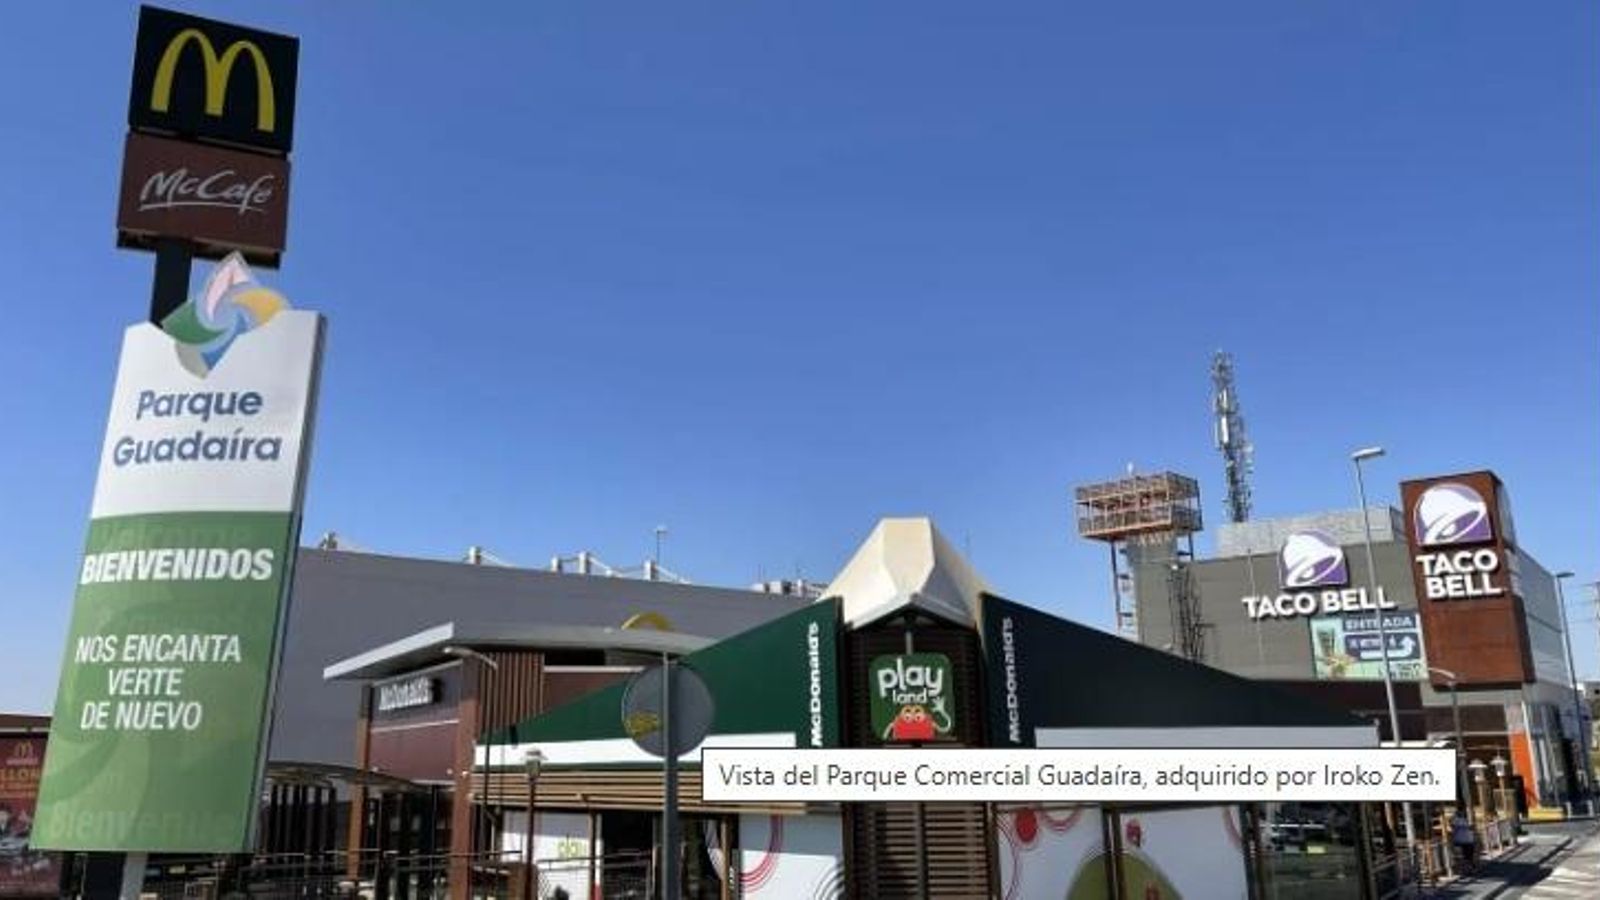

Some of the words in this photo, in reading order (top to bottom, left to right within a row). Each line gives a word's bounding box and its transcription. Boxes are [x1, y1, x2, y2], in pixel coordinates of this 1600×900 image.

[138, 168, 275, 214] McCafé
[136, 390, 263, 421] Parque
[113, 428, 282, 467] Guadaíra
[80, 547, 275, 584] BIENVENIDOS
[1416, 549, 1499, 577] TACO
[1426, 572, 1504, 599] BELL
[1242, 591, 1316, 619] TACO
[1322, 586, 1396, 612] BELL
[75, 635, 118, 663] NOS
[121, 633, 242, 662] ENCANTA
[107, 668, 184, 696] VERTE
[877, 657, 944, 698] play
[892, 687, 927, 704] land
[80, 702, 108, 730] DE
[114, 701, 203, 730] NUEVO
